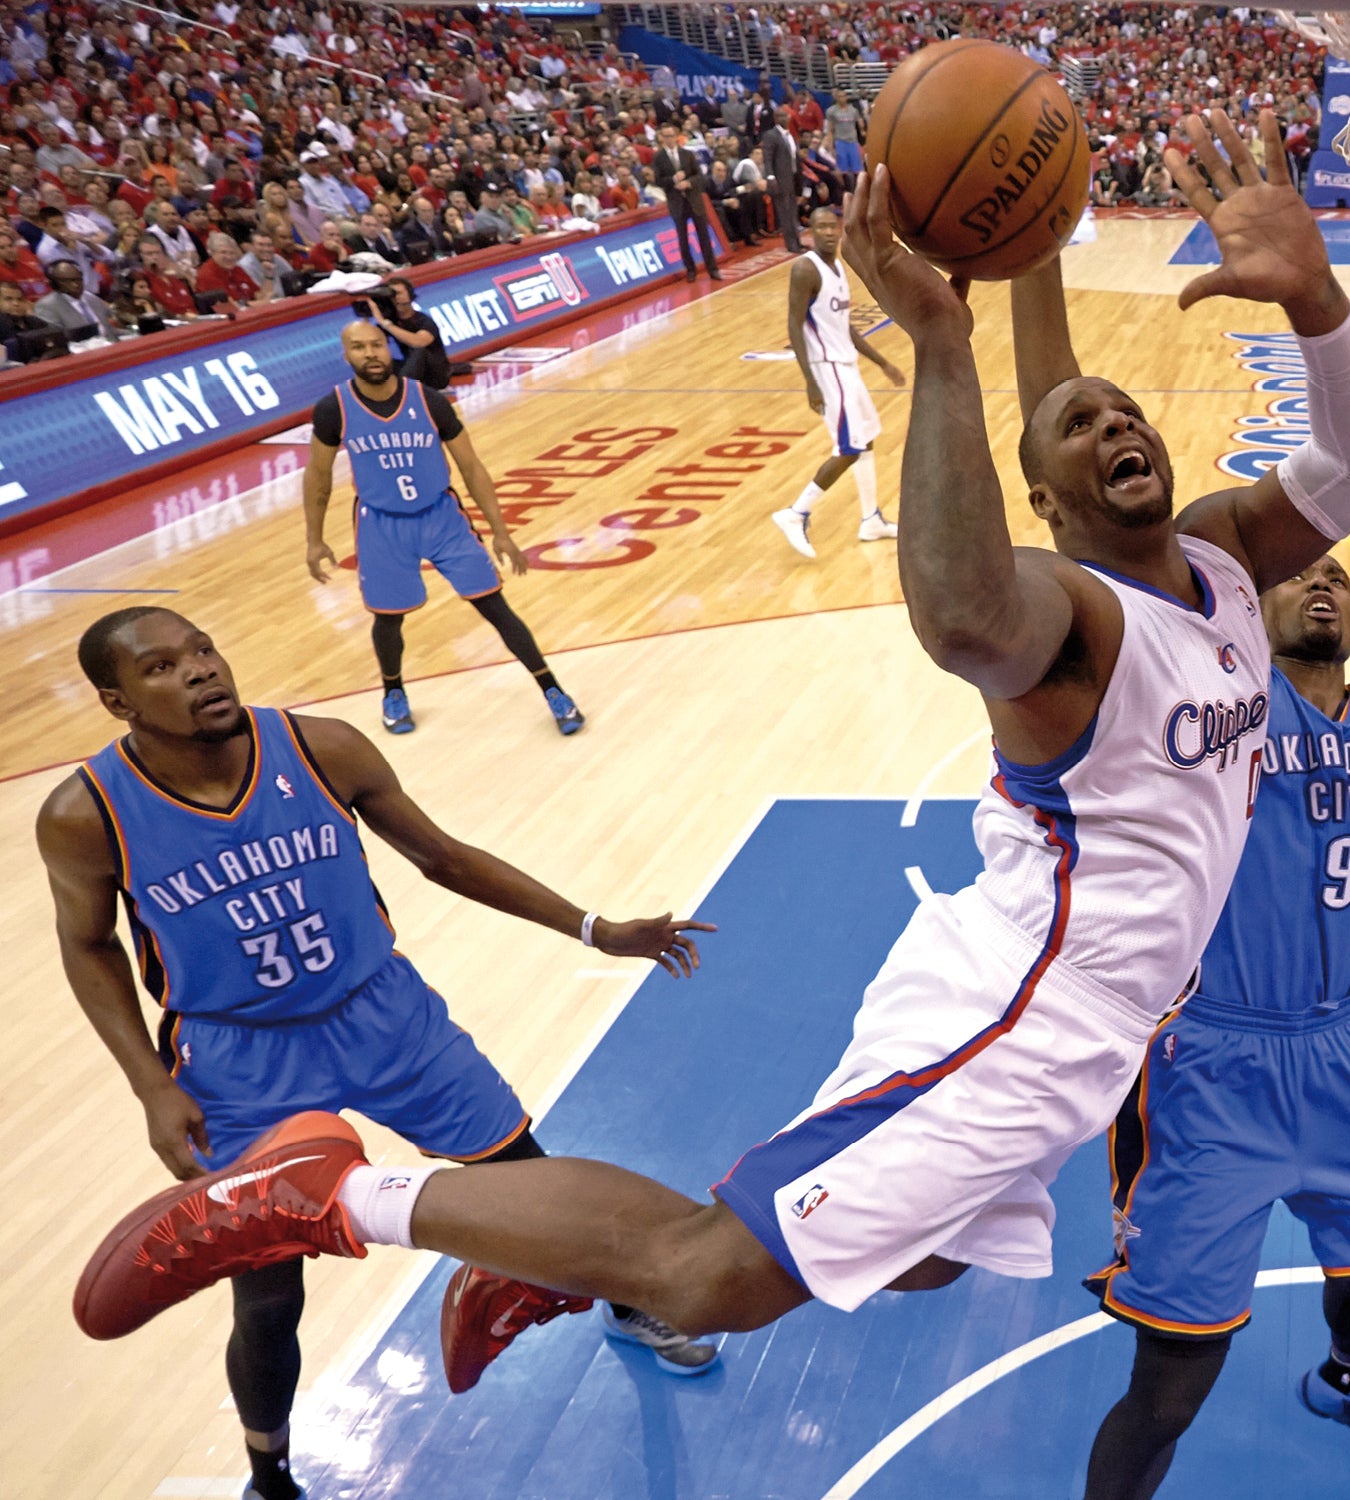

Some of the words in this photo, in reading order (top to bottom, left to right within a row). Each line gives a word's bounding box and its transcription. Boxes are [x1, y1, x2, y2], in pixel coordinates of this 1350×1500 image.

[959, 98, 1069, 244] SPALDING
[93, 366, 220, 455] MAY
[204, 351, 280, 416] 16
[348, 432, 434, 454] OKLAHOMA
[378, 452, 414, 470] CITY
[396, 474, 418, 501] 6
[522, 426, 808, 571] Center
[1163, 691, 1268, 773] Clippe
[146, 823, 338, 914] OKLAHOMA
[225, 877, 307, 931] CITY
[240, 911, 336, 988] 35
